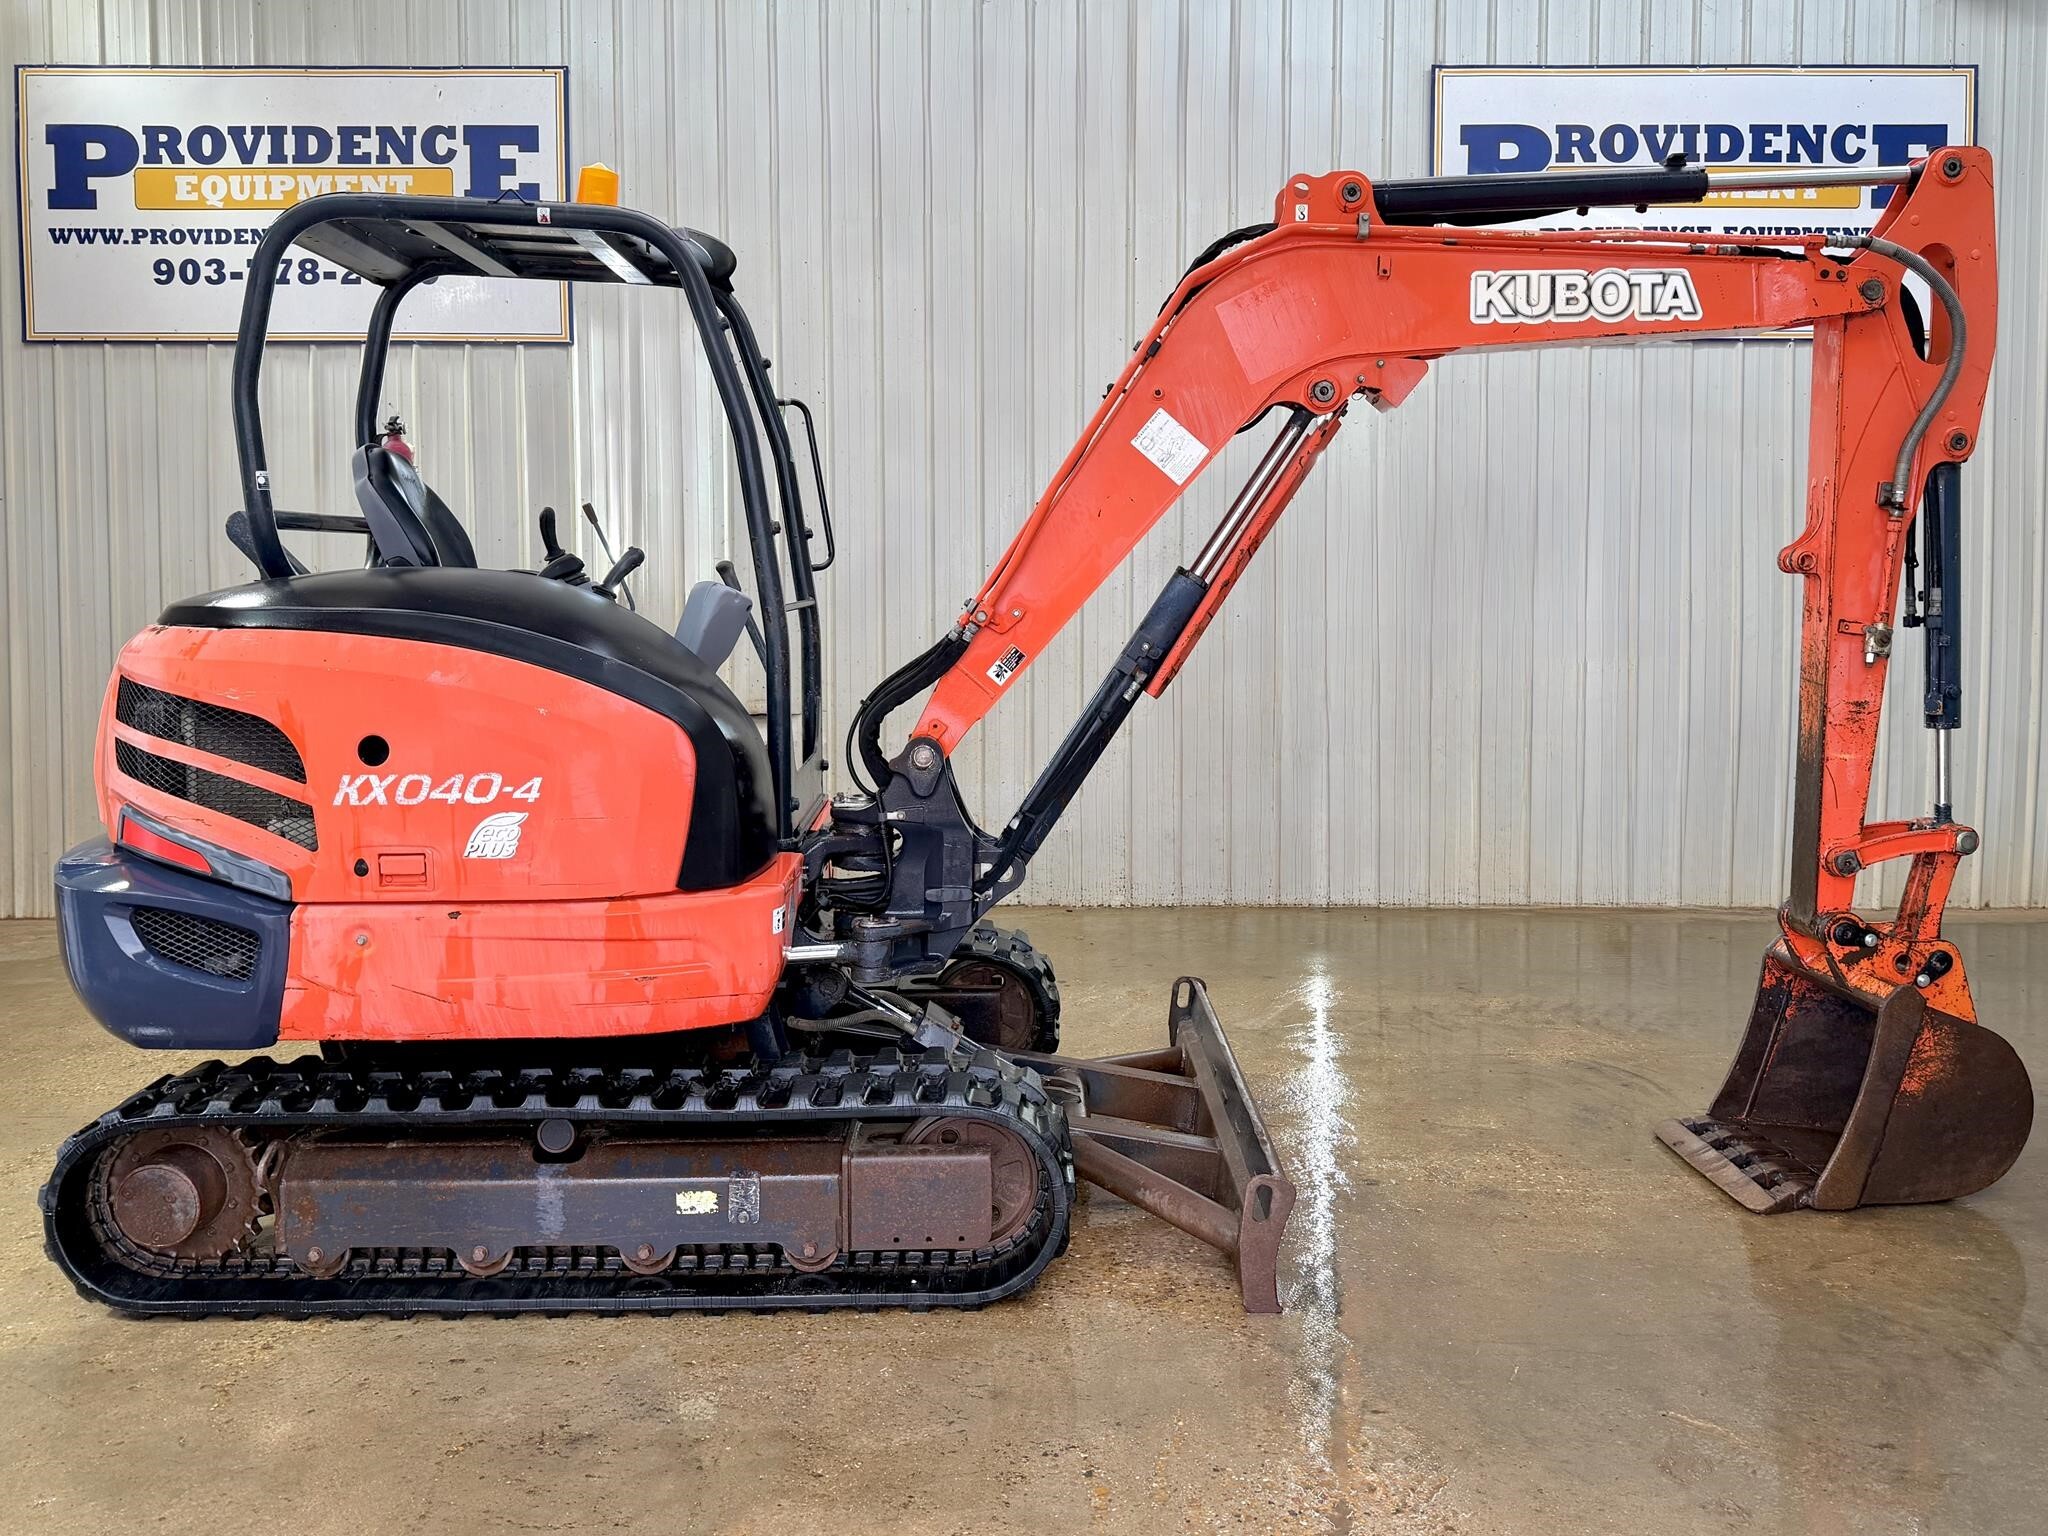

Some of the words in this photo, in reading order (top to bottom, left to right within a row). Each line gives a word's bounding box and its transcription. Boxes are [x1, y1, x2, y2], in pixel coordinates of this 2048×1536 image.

[45, 124, 540, 209] PROVIDENCE
[174, 174, 413, 208] EQUIPMENT
[48, 228, 265, 245] WWW.PROVIDEN
[1473, 270, 1699, 319] KUBOTA
[332, 772, 543, 806] KX040-4
[463, 842, 518, 858] PLUS
